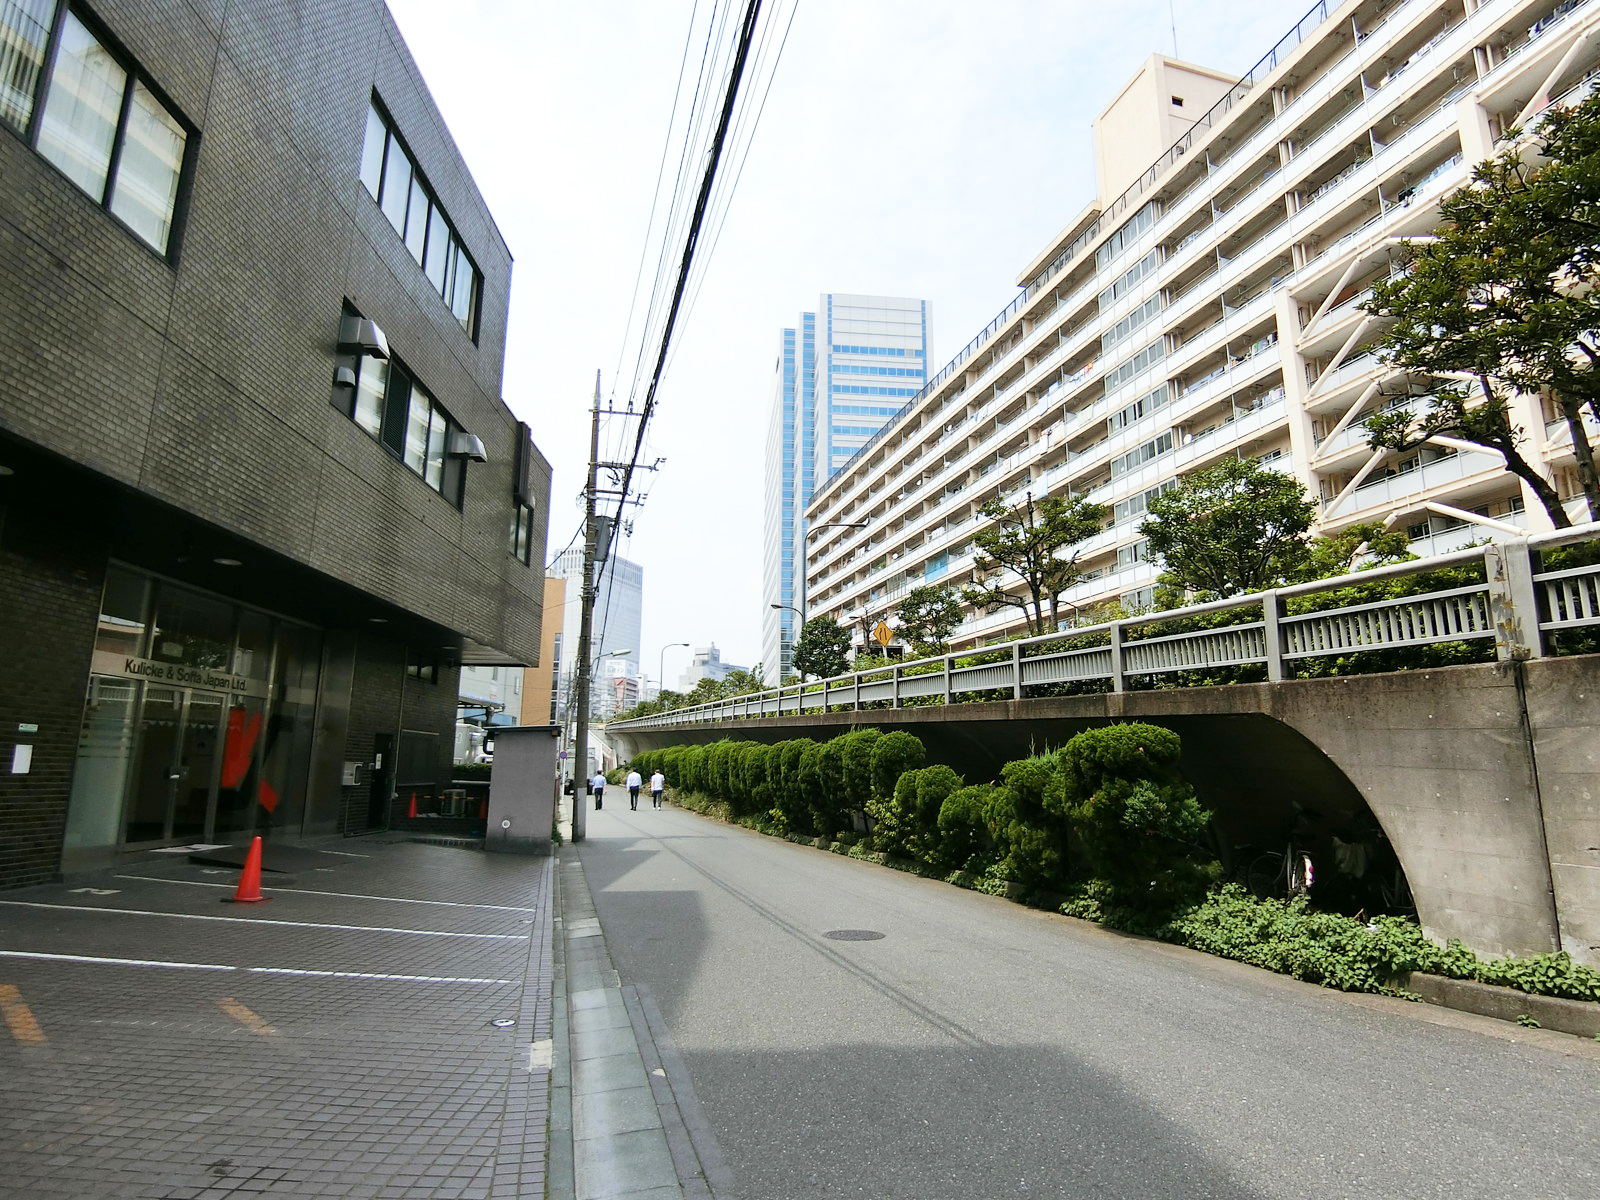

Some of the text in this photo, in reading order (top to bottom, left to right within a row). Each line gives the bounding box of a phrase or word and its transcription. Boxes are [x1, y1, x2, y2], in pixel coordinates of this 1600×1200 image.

[125, 658, 163, 678] Kulicke
[166, 666, 174, 680] &
[203, 672, 230, 689] Japan
